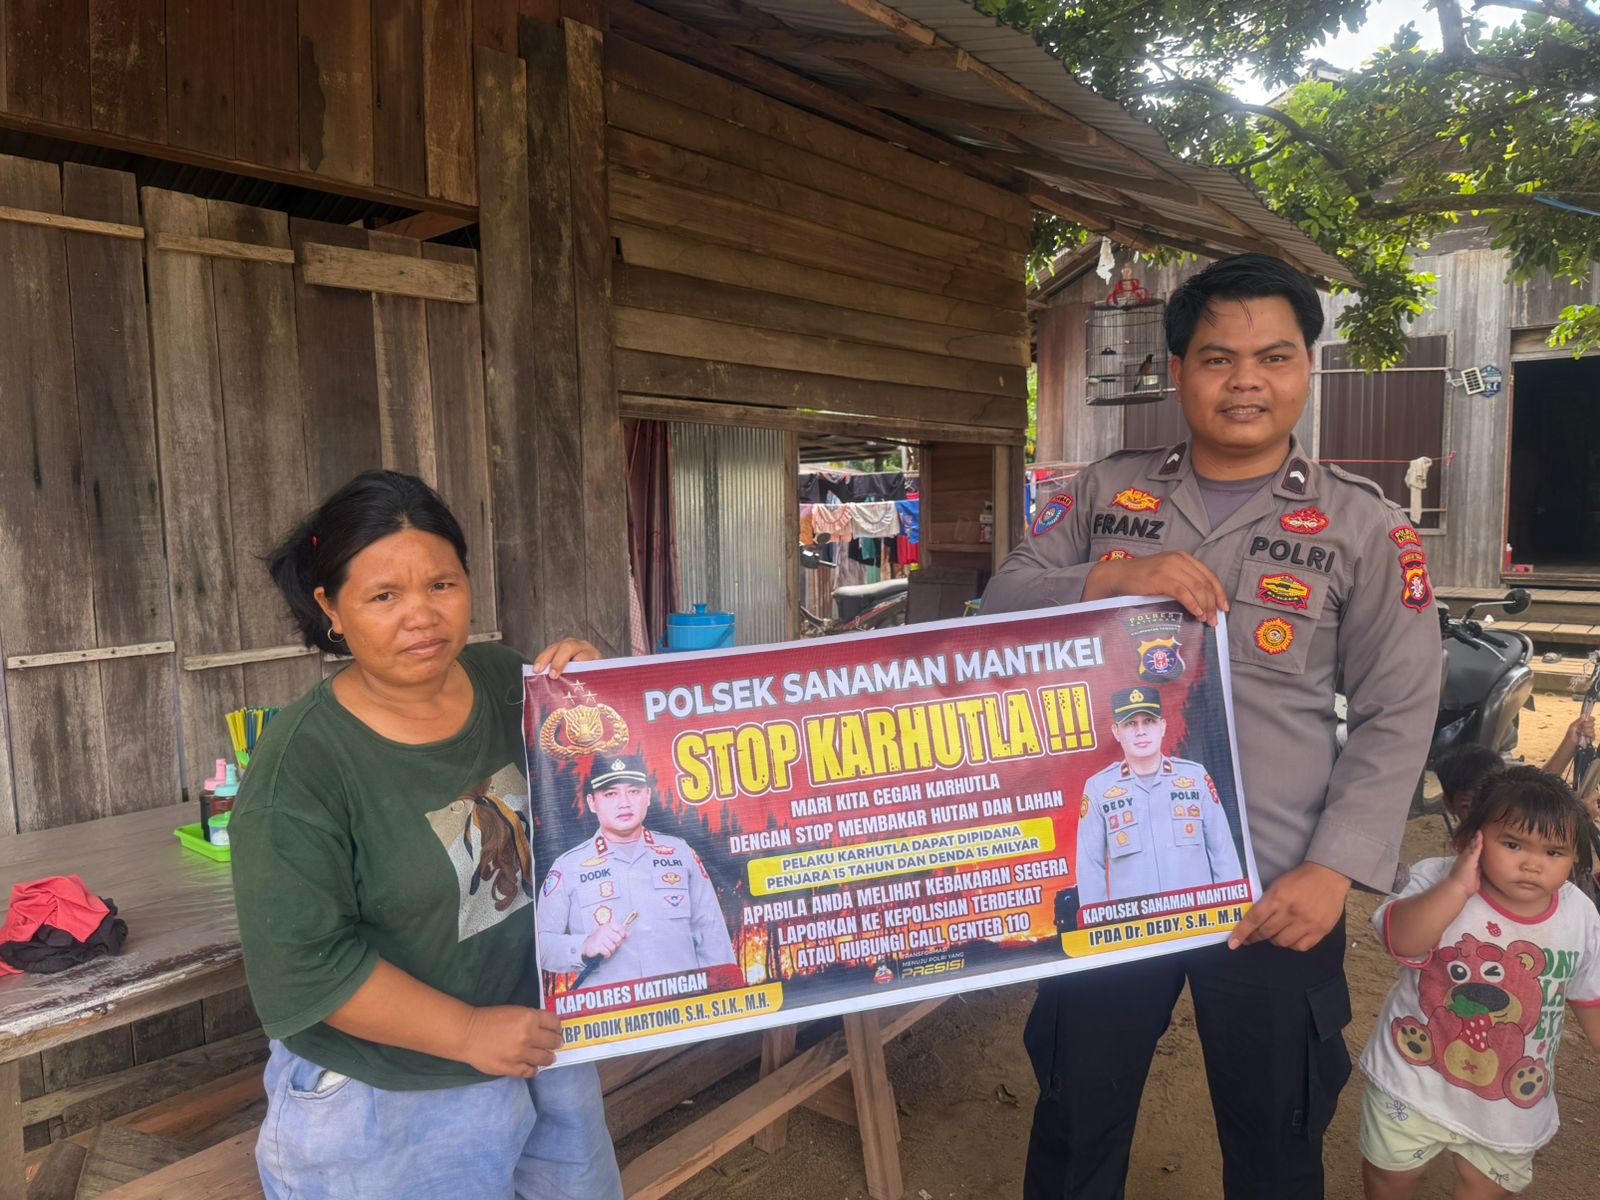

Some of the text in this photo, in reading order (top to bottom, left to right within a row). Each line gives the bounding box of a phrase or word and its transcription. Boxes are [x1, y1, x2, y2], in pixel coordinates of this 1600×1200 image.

[1092, 513, 1165, 540] FRANZ
[1250, 536, 1335, 573] POLRI
[644, 636, 1104, 721] POLSEK SANAMAN MANTIKEI
[676, 686, 1094, 802] STOP KARHUTLA !!!
[791, 773, 1000, 817] MARI KITA CEGAH KARHUTLA
[1102, 798, 1133, 813] DEDY
[1170, 791, 1199, 801] POLRI
[730, 790, 1064, 853] DENGAN STOP MEMBAKAR HUTAN DAN LAHAN
[653, 859, 682, 868] POLRI
[767, 838, 1038, 889] PENJARA 15 TAHUN DAN DENDA 15 MILYAR
[782, 826, 1021, 870] PELAKU KARHUTLA DAPAT DIPIDANA
[580, 868, 612, 883] DODIK
[744, 858, 1068, 925] APABILA ANDA MELIHAT KEBAKARAN SEGERA
[778, 886, 1042, 945] LAPORKAN KE KEPOLISIAN TERDEKAT
[1082, 884, 1248, 924] KAPOLSEK SANAMAN MANTIKEI
[798, 913, 1031, 967] ATAU HUBUNGI CALL CENTER 110
[1089, 927, 1124, 946] IPDA
[1125, 924, 1143, 940] Dr.
[1147, 917, 1183, 936] DEDY,
[1186, 912, 1215, 929] S.H.,
[902, 951, 965, 967] MENUJU POLRI YANG
[902, 959, 965, 979] PRESISI
[555, 972, 708, 1015] KAPOLRES KATINGAN
[560, 992, 770, 1044] KBP DODIK HARTONO, S.H., S.I.K., M.H.
